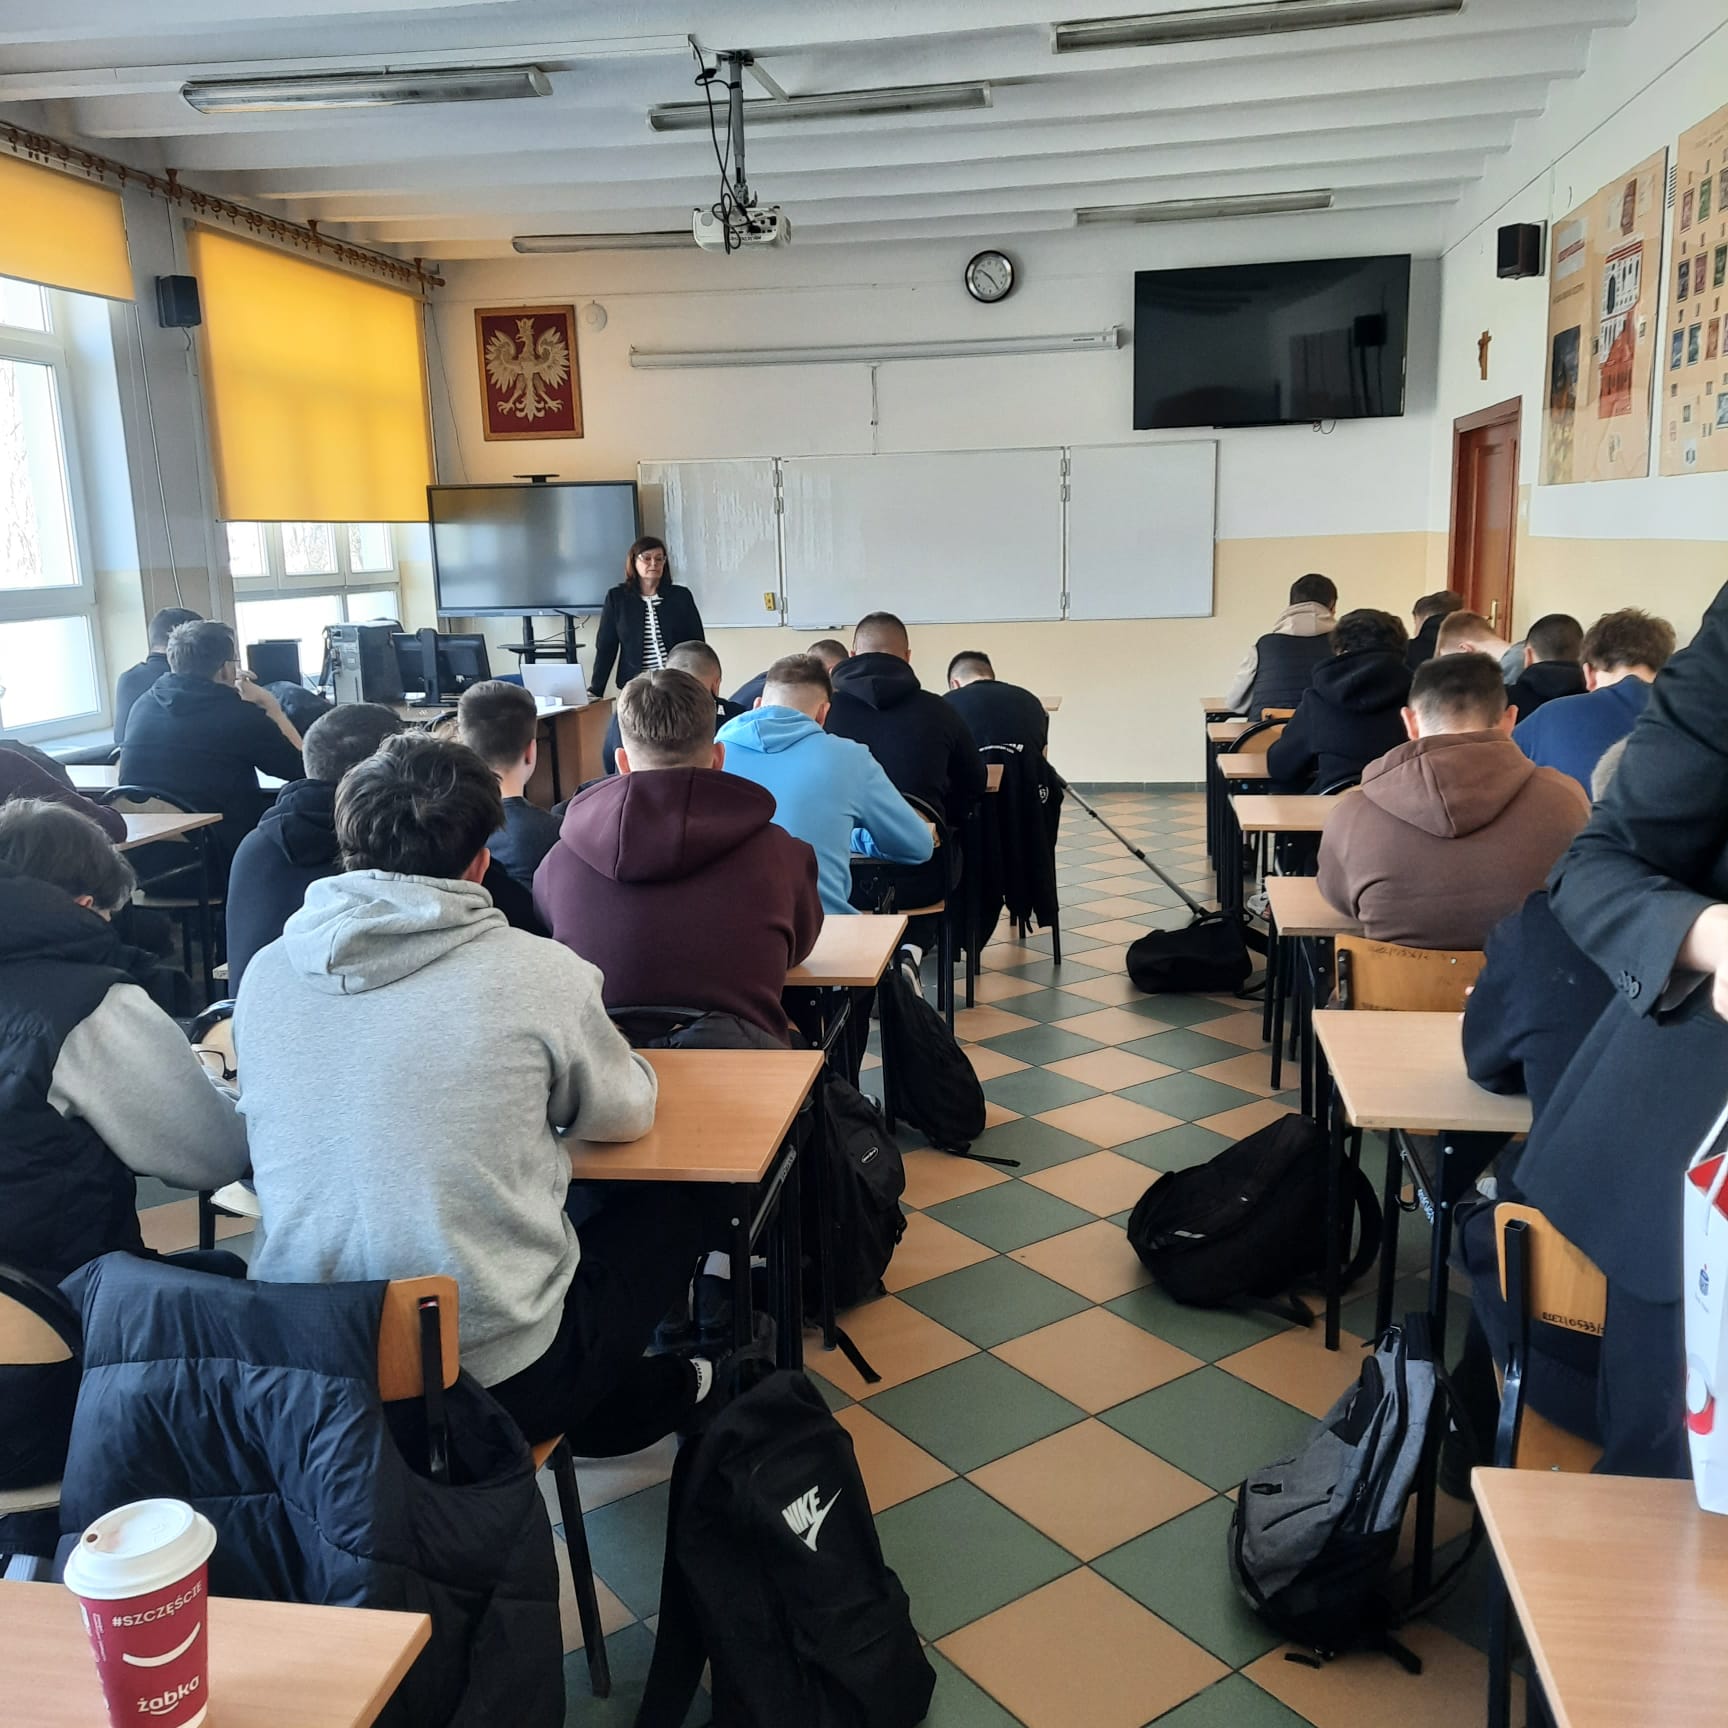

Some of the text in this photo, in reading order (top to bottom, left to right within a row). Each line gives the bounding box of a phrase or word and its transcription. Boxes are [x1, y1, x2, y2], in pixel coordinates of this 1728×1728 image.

[782, 1485, 823, 1535] NIKE
[112, 1580, 203, 1627] #SZCZĘŚCIE
[137, 1675, 200, 1713] żabka
